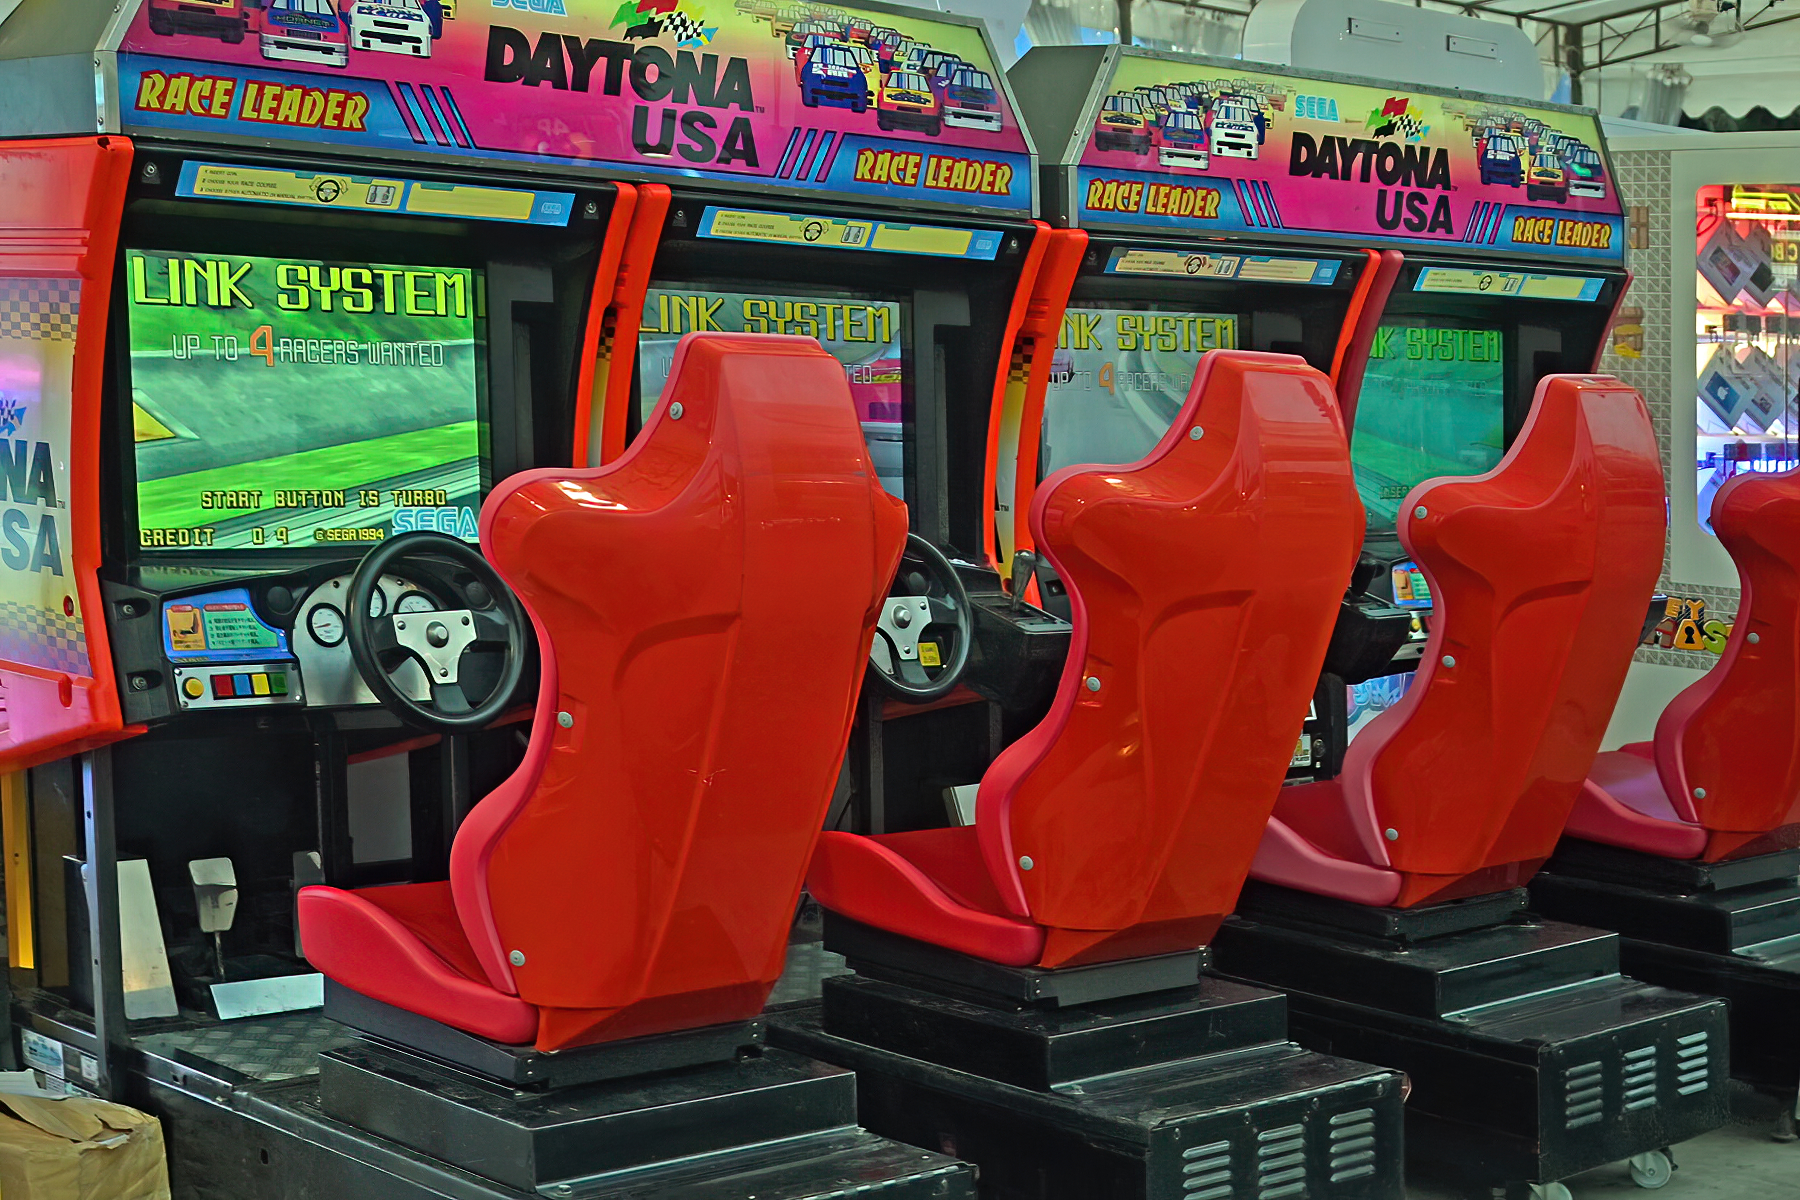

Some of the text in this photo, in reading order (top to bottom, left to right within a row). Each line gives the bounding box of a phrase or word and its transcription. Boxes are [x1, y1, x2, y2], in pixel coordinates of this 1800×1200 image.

[484, 24, 755, 112] DAYTONA
[136, 71, 368, 130] RACE LEADER
[1295, 94, 1340, 123] SEGA
[632, 105, 759, 167] USA
[855, 149, 1012, 194] RACE LEADER
[1289, 131, 1452, 191] DAYTONA
[1087, 179, 1220, 218] RACE LEADER
[1376, 188, 1454, 234] USA
[1512, 216, 1611, 248] RACE LEADER
[132, 255, 467, 317] LINK SYSTEM
[743, 300, 892, 343] SYSTEM
[1055, 313, 1235, 351] NK SYSTEM
[172, 325, 443, 367] UP TO 4 RACERS WANTED
[1406, 328, 1500, 362] SYSTEM
[842, 364, 871, 384] TED
[1098, 362, 1114, 395] 4
[201, 490, 446, 508] START BUTTON IS TURBO
[139, 528, 215, 548] CREDIT
[358, 528, 384, 541] 1994
[391, 506, 479, 538] SEGA
